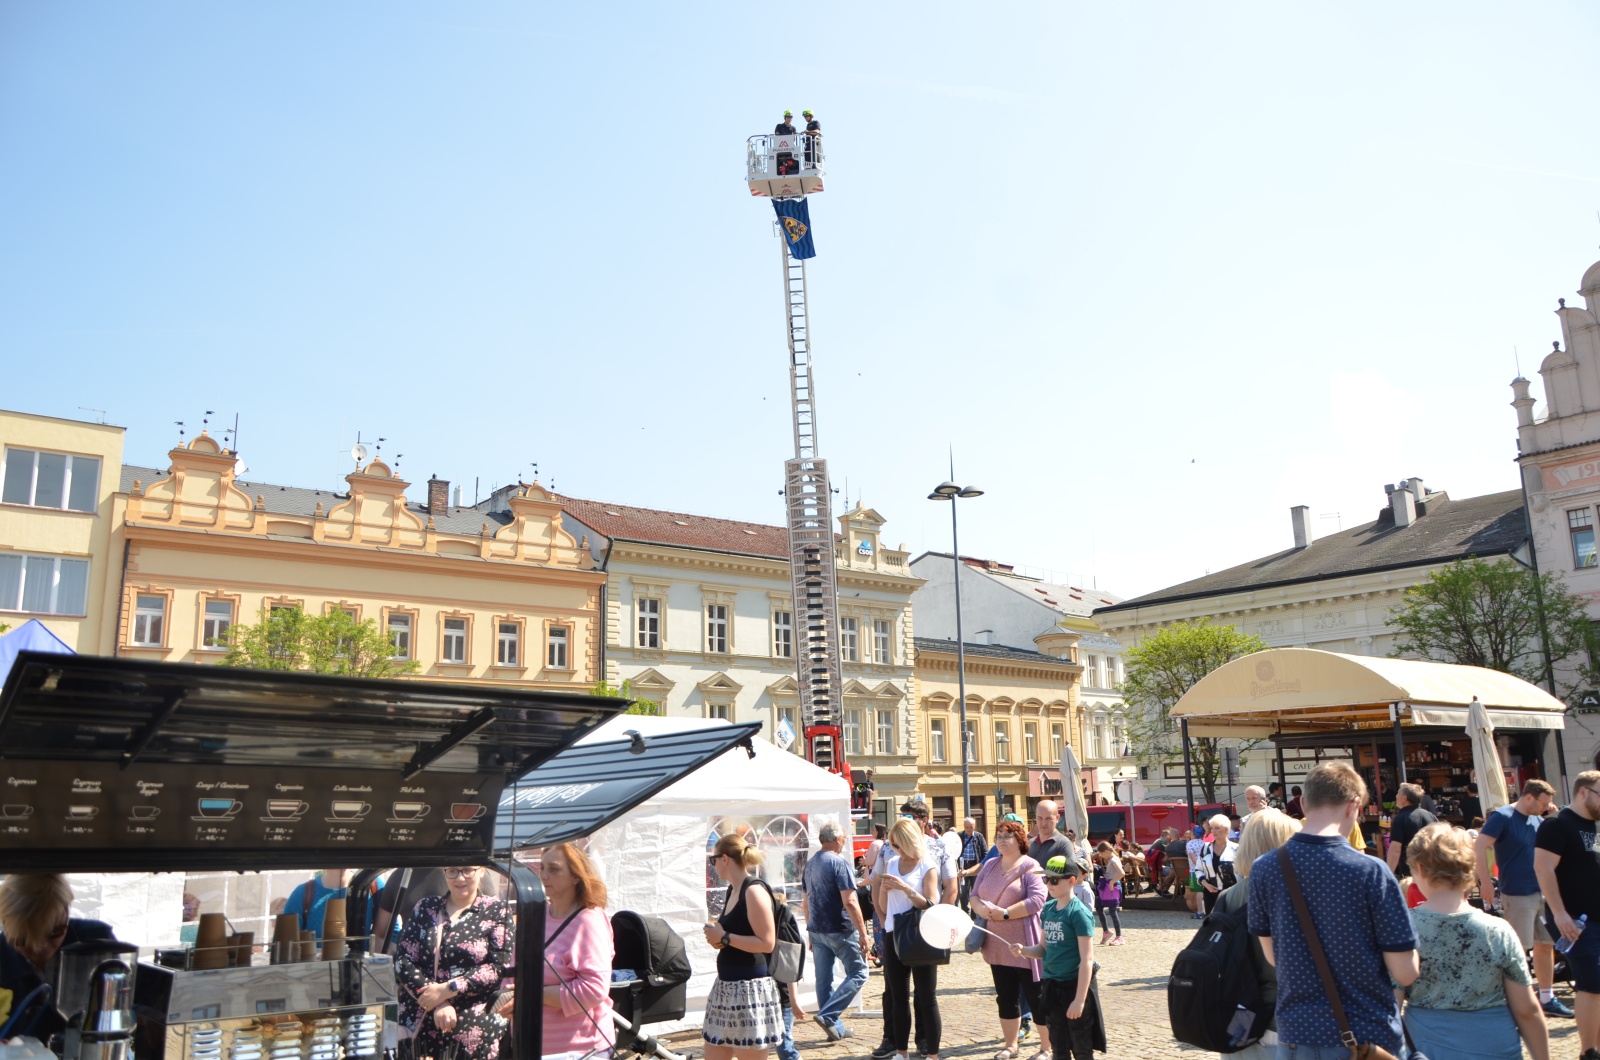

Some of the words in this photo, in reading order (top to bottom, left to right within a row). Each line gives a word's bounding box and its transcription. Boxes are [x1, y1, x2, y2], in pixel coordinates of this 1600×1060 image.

[1250, 681, 1275, 700] Pilsner
[1274, 678, 1302, 694] Urquell
[7, 777, 37, 787] Espresso
[72, 778, 102, 787] Espresso
[136, 780, 164, 789] Espresso
[220, 781, 250, 789] Americano
[1044, 920, 1064, 931] GAME
